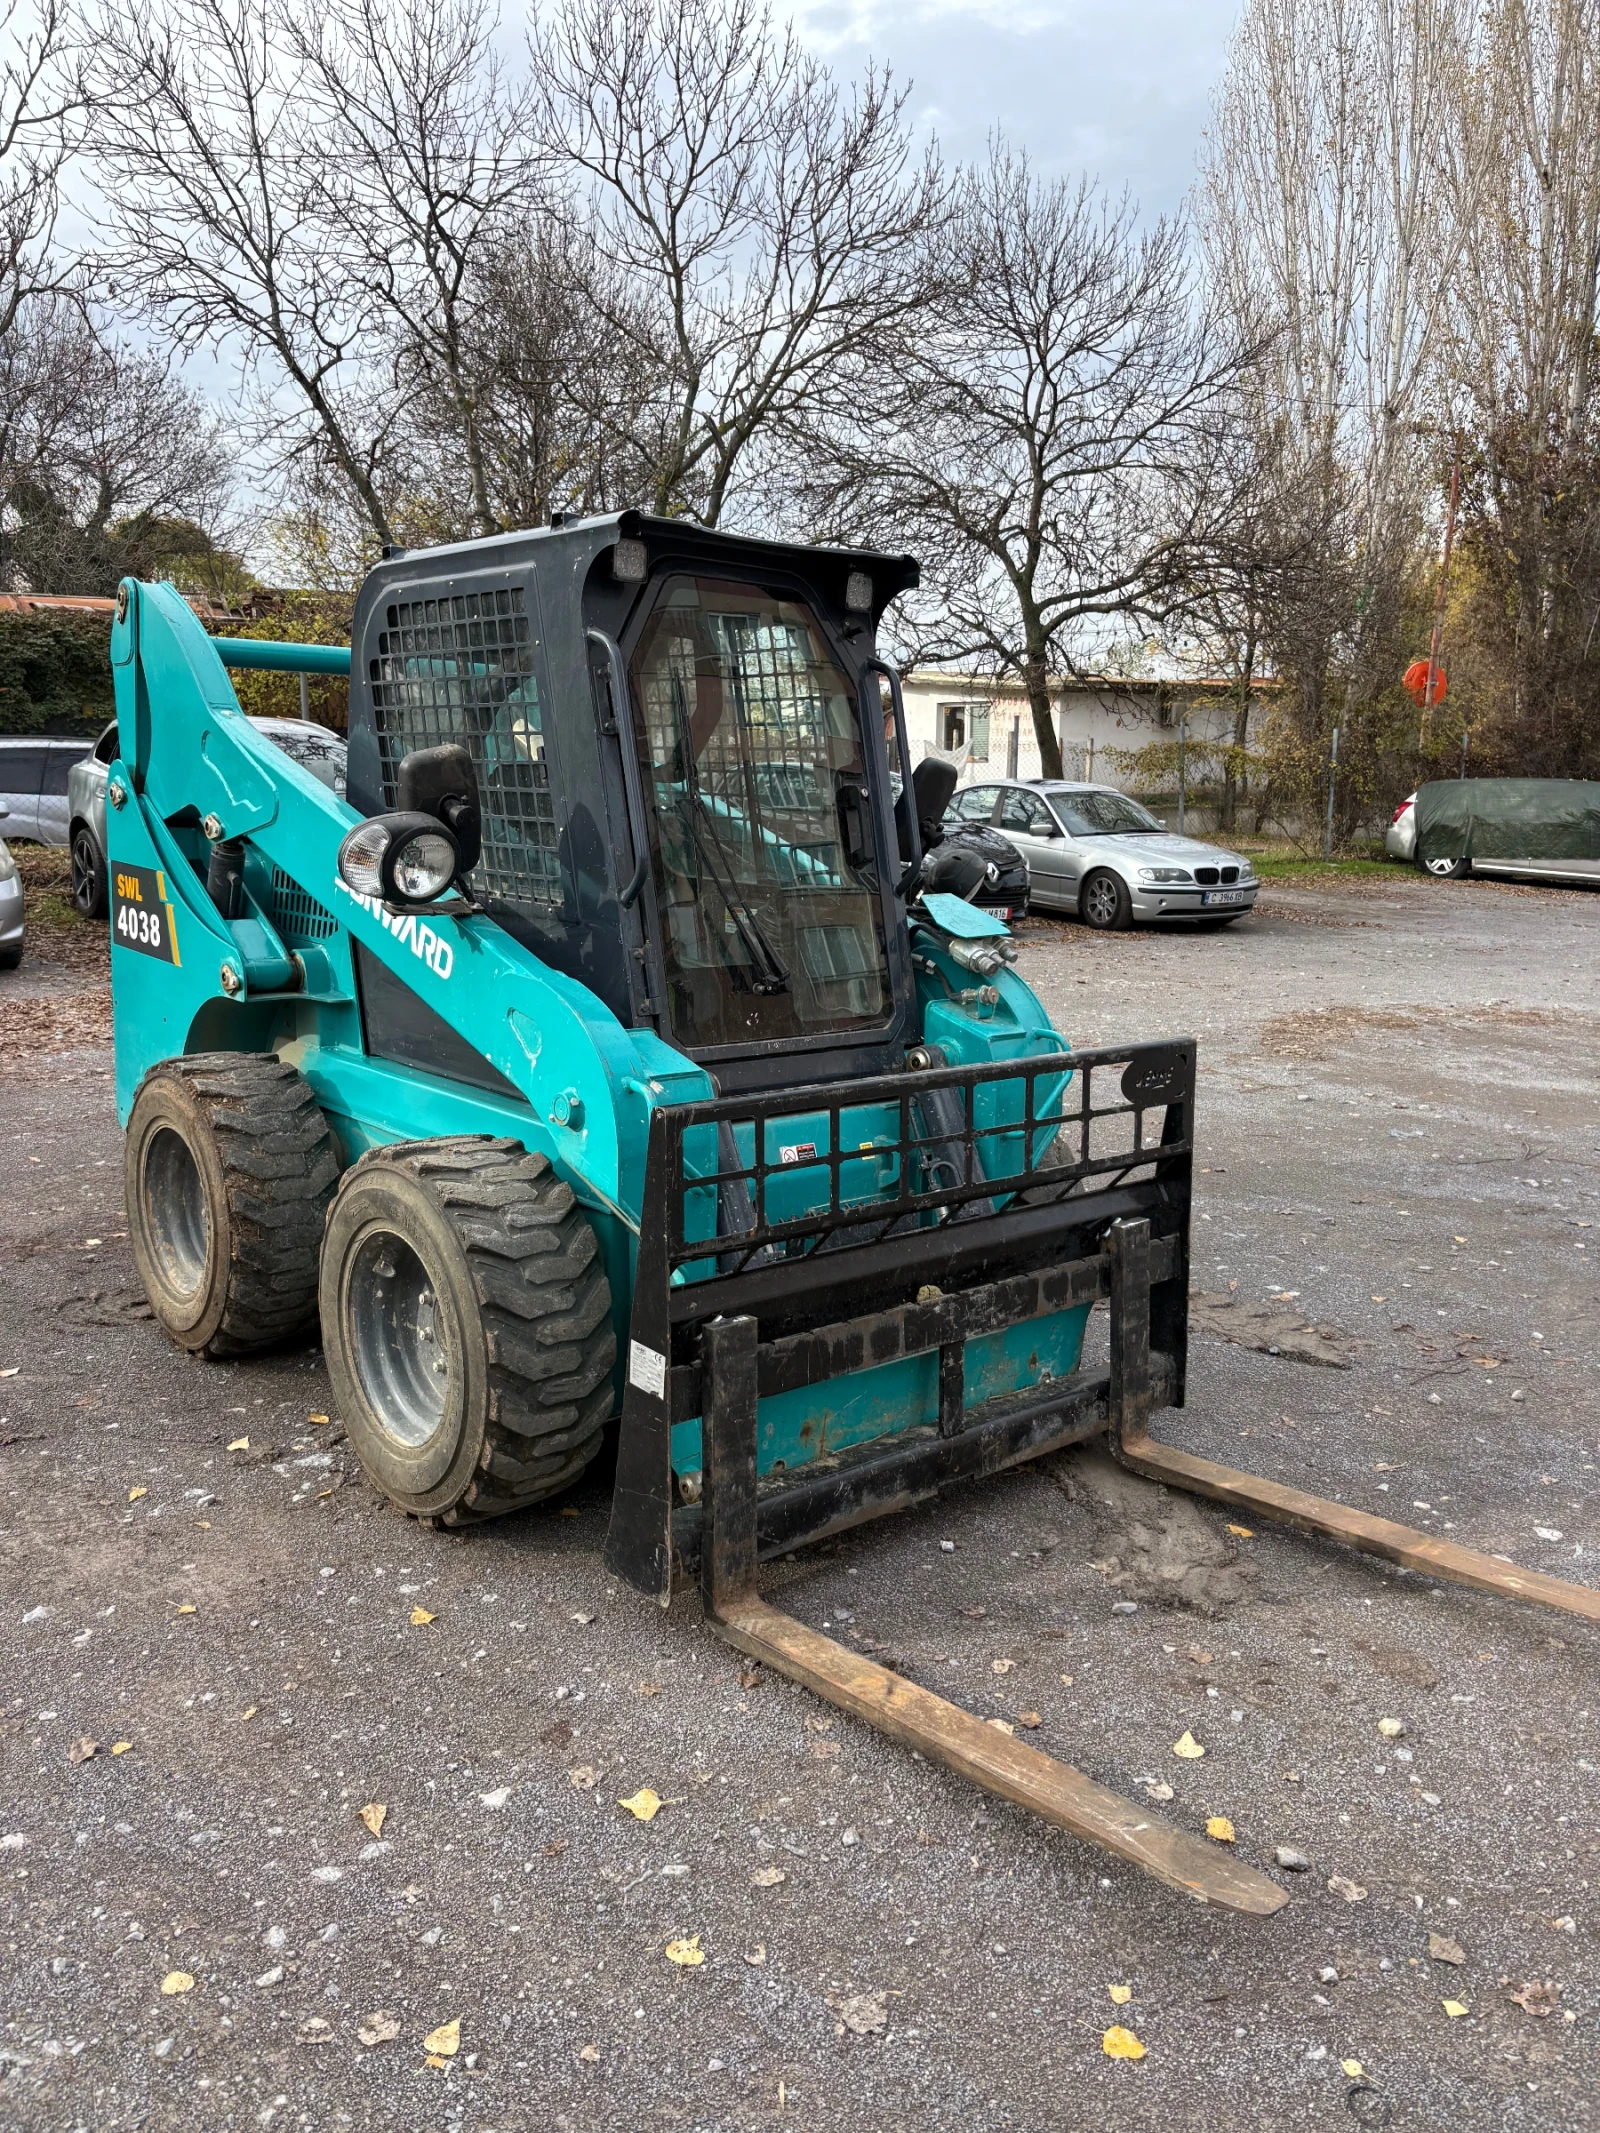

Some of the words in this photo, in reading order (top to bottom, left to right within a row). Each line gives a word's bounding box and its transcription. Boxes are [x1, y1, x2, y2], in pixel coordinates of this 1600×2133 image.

[117, 873, 142, 902] SWL
[117, 904, 161, 947] 4038
[335, 876, 454, 980] NWARD
